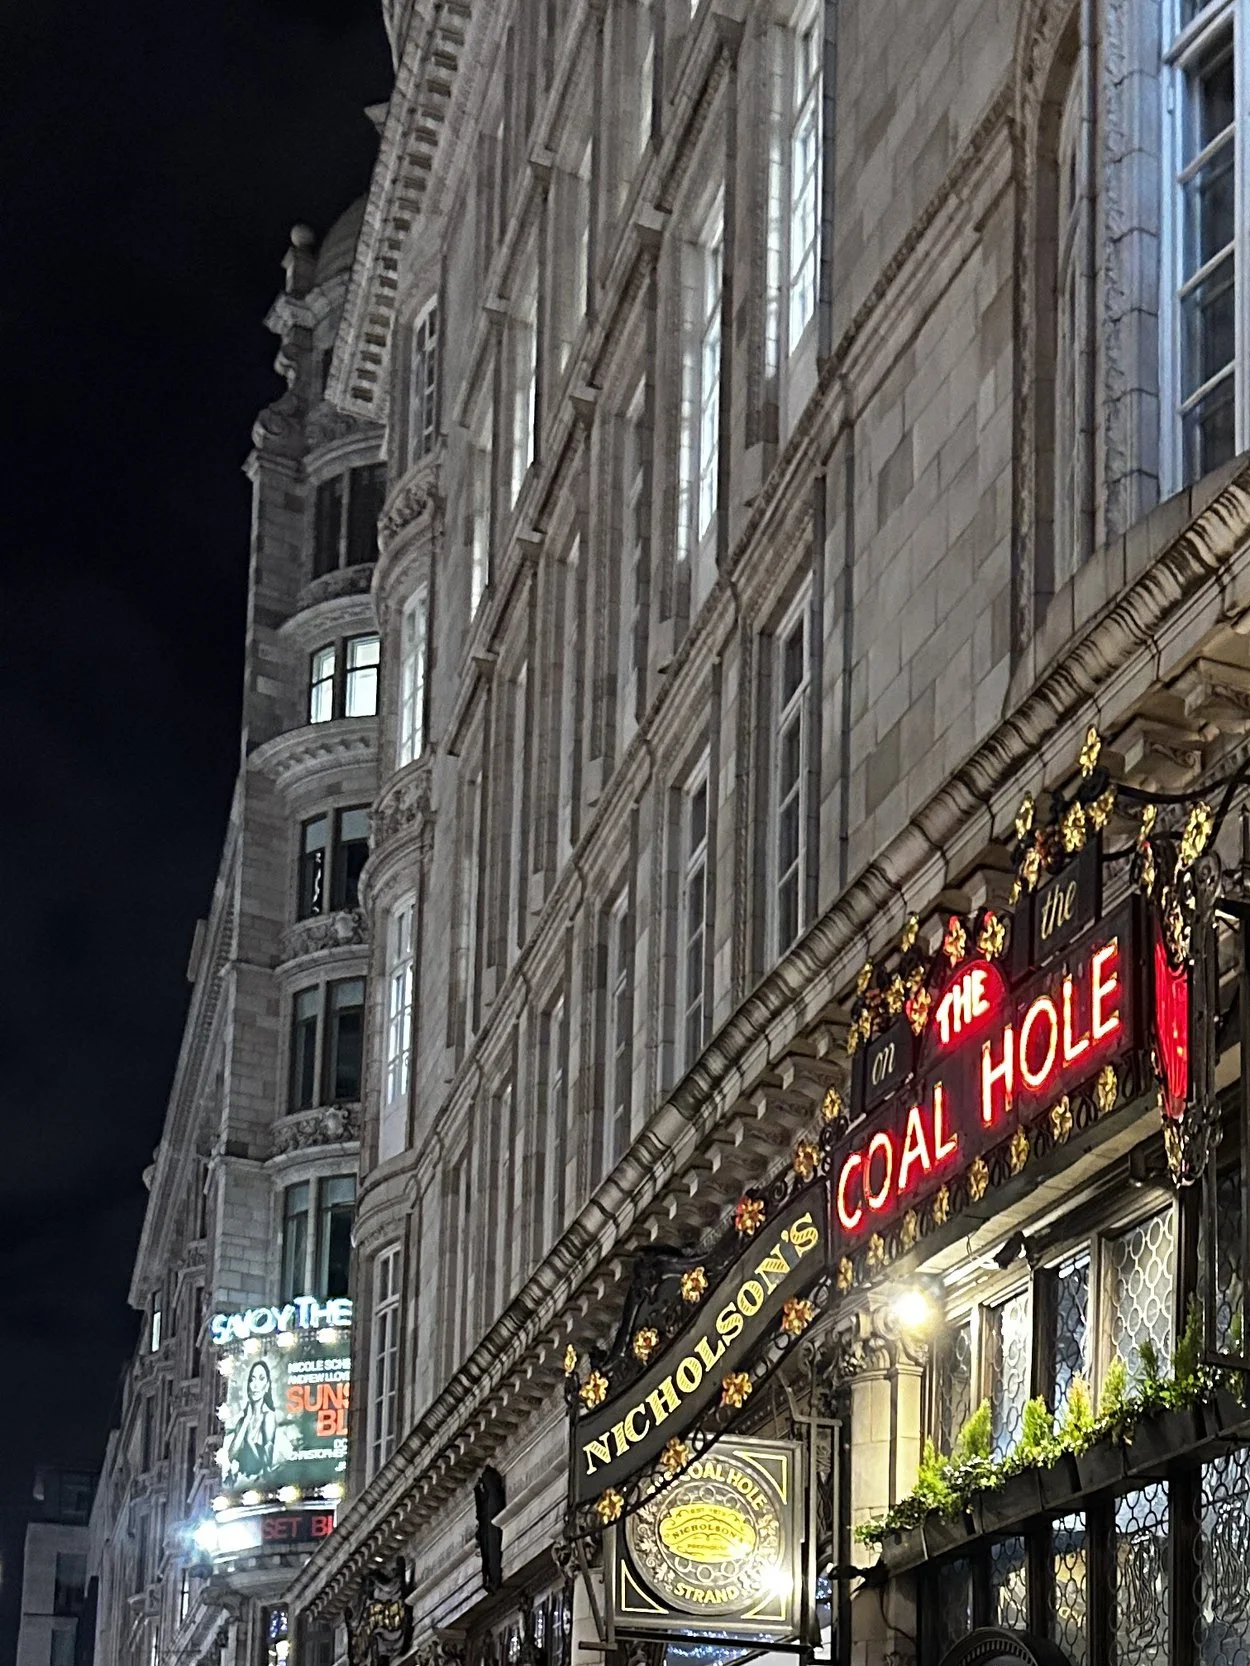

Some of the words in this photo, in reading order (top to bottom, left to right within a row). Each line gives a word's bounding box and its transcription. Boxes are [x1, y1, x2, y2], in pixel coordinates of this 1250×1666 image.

[1040, 879, 1077, 940] the
[936, 969, 990, 1045] THE
[836, 1081, 959, 1232] COAL
[981, 936, 1120, 1128] HOLE
[211, 1303, 295, 1344] SAVOY
[583, 1212, 819, 1475] NICHOLSON'S
[287, 1359, 324, 1374] NICOLE
[677, 1461, 726, 1481] OAL
[726, 1468, 768, 1511] HOLE
[673, 1582, 740, 1605] STRAND
